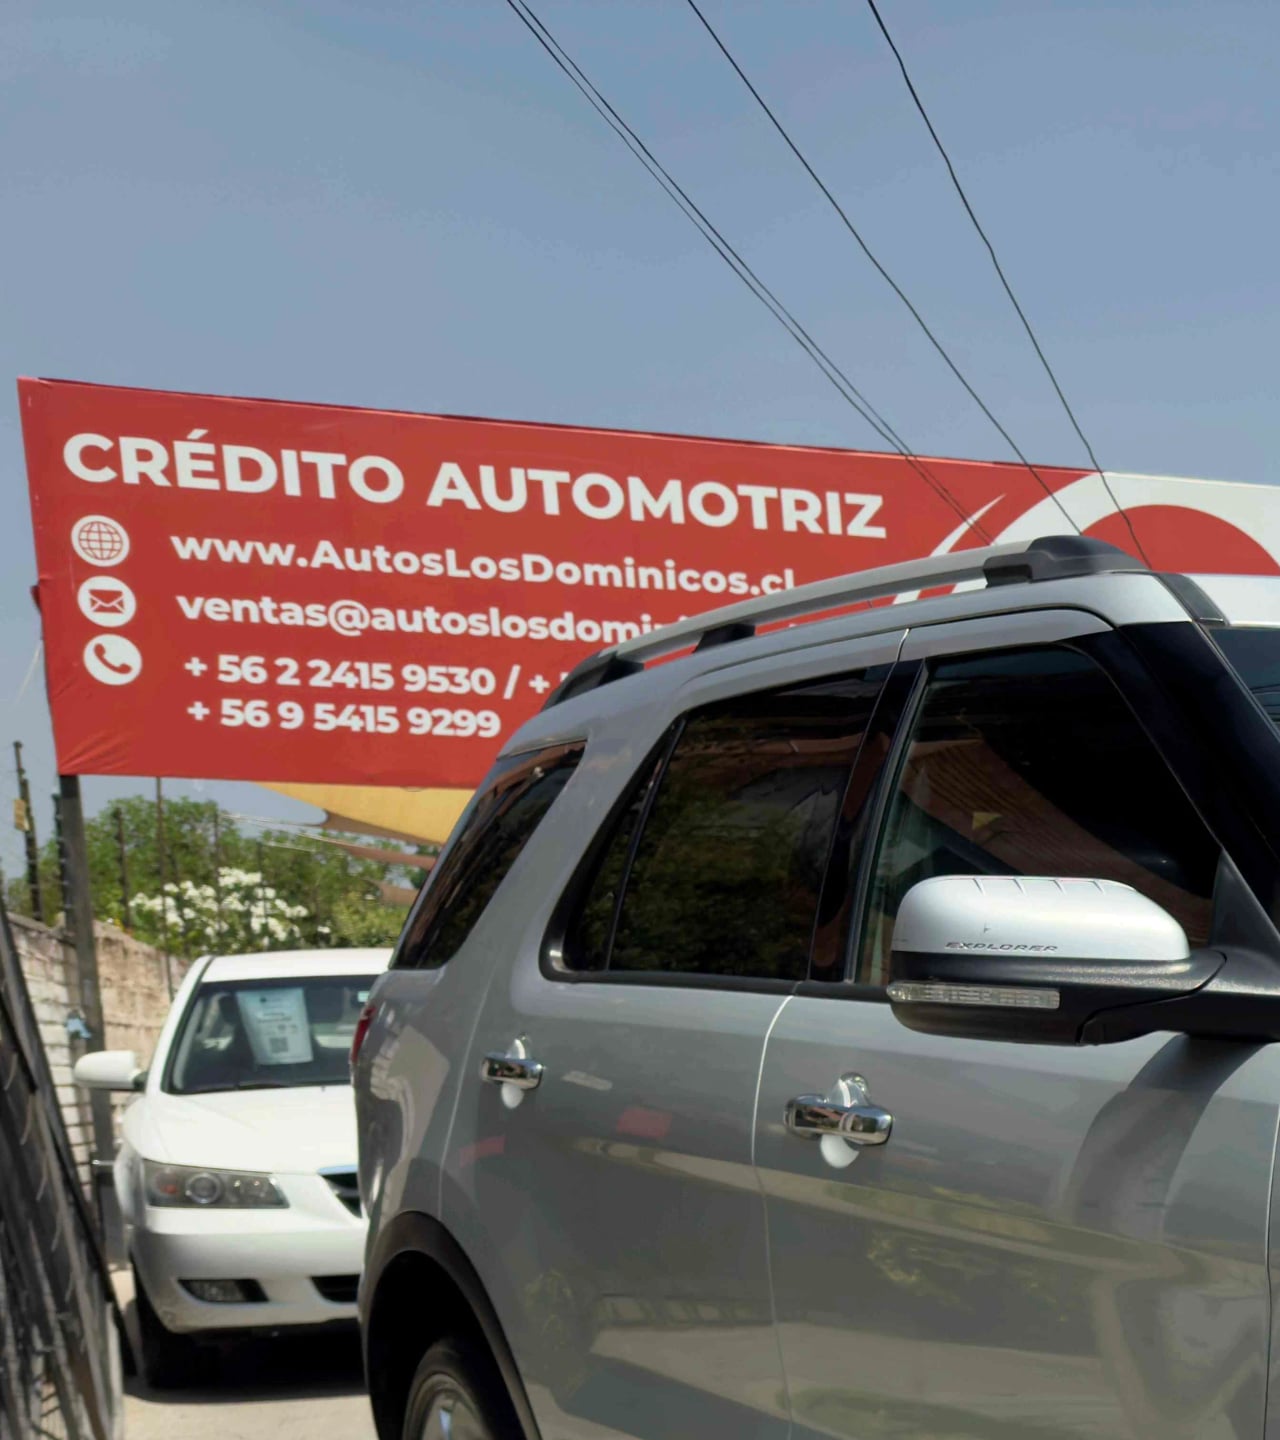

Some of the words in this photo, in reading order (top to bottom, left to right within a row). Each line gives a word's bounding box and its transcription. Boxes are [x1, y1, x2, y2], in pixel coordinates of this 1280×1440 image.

[64, 429, 404, 504] CRÉDITO
[427, 462, 887, 539] AUTOMOTRIZ
[171, 535, 794, 595] www.AutosLosDominicos.cl
[217, 654, 268, 685] 56
[275, 657, 301, 686] 2
[307, 659, 394, 691] 2415
[402, 664, 496, 696] 9530
[220, 698, 271, 728] 56
[278, 701, 304, 729] 9
[313, 703, 400, 733] 5415
[407, 707, 501, 738] 9299
[945, 941, 1058, 952] EXPLORER
